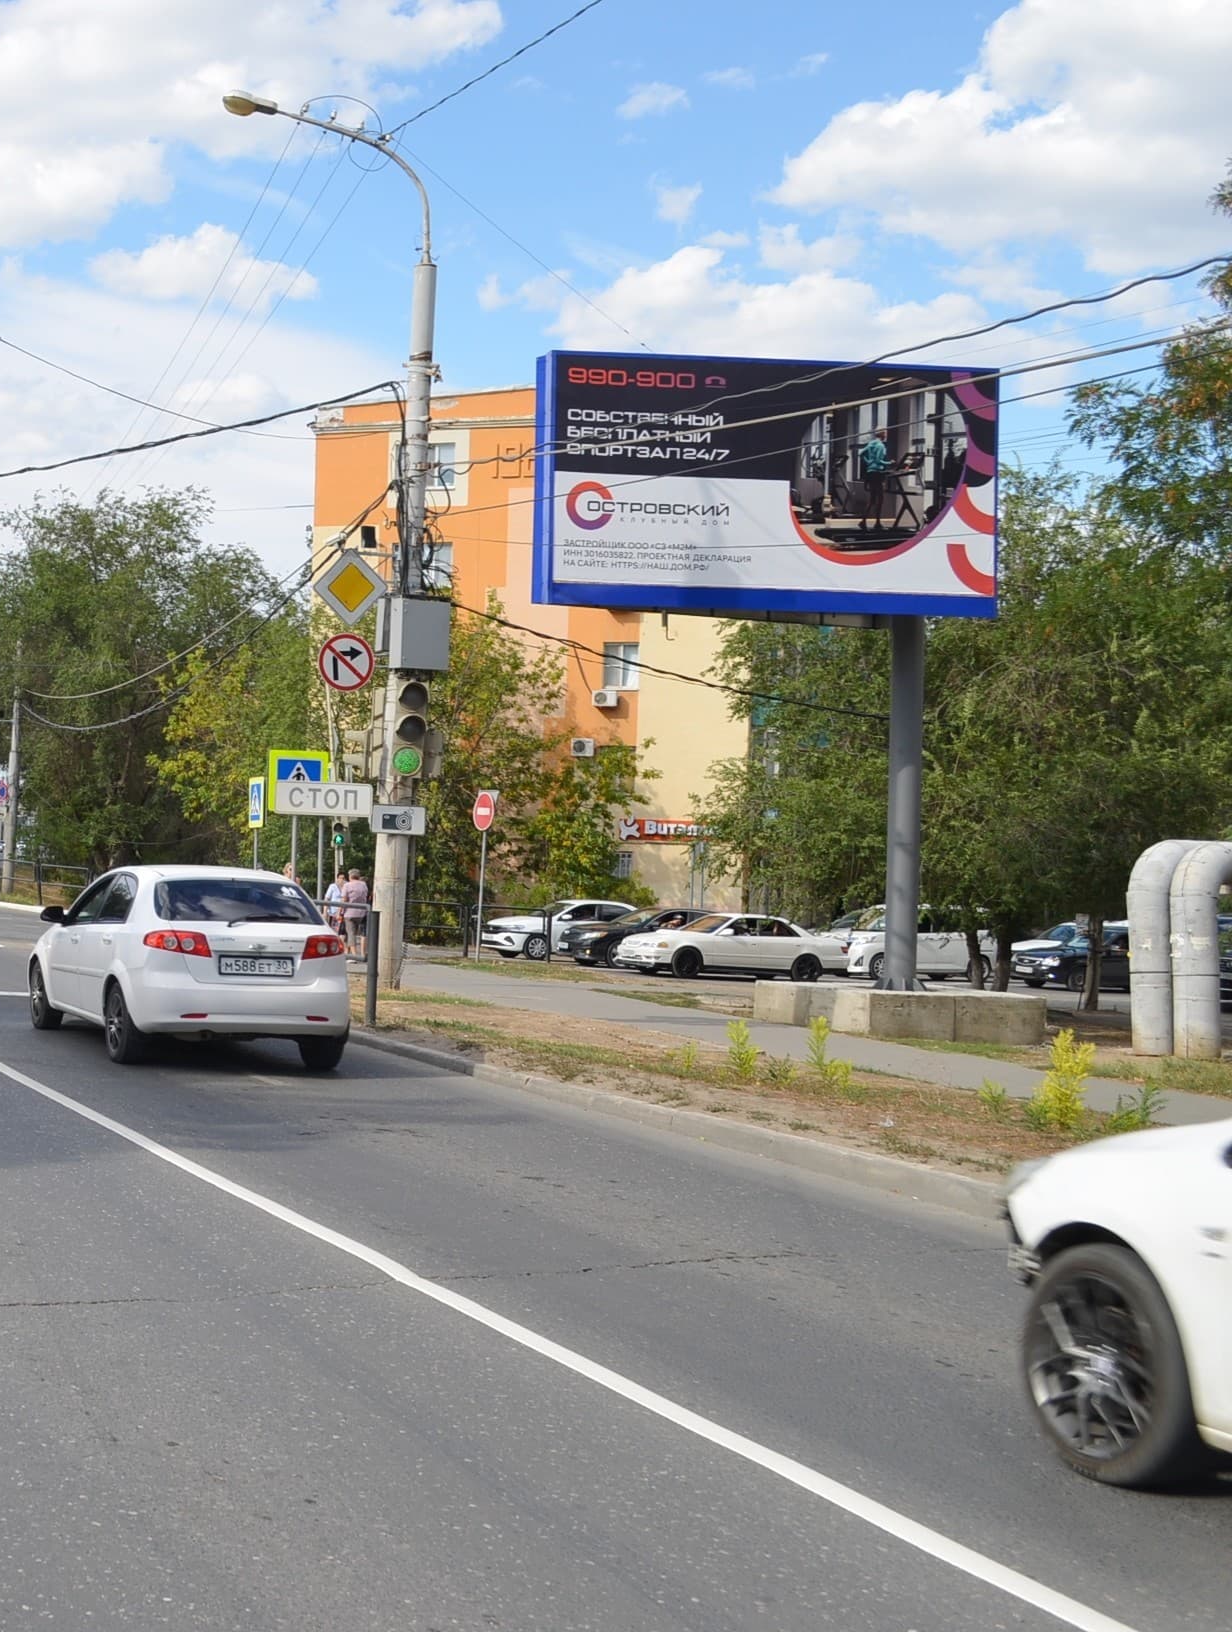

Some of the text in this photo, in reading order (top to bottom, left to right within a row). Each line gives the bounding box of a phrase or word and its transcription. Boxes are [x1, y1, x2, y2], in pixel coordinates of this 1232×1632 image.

[568, 367, 696, 389] 990-900
[567, 408, 724, 427] СОБСТВЕННЫЙ
[567, 443, 730, 461] СПОРТЗАЛ 24/7
[701, 519, 730, 527] ДОМ
[563, 549, 583, 557] ИНН
[637, 552, 690, 561] ПРОЕКТНАЯ
[692, 554, 752, 563] ДЕКЛАРАЦИЯ
[563, 559, 576, 567] НА
[289, 787, 358, 811] СТОП
